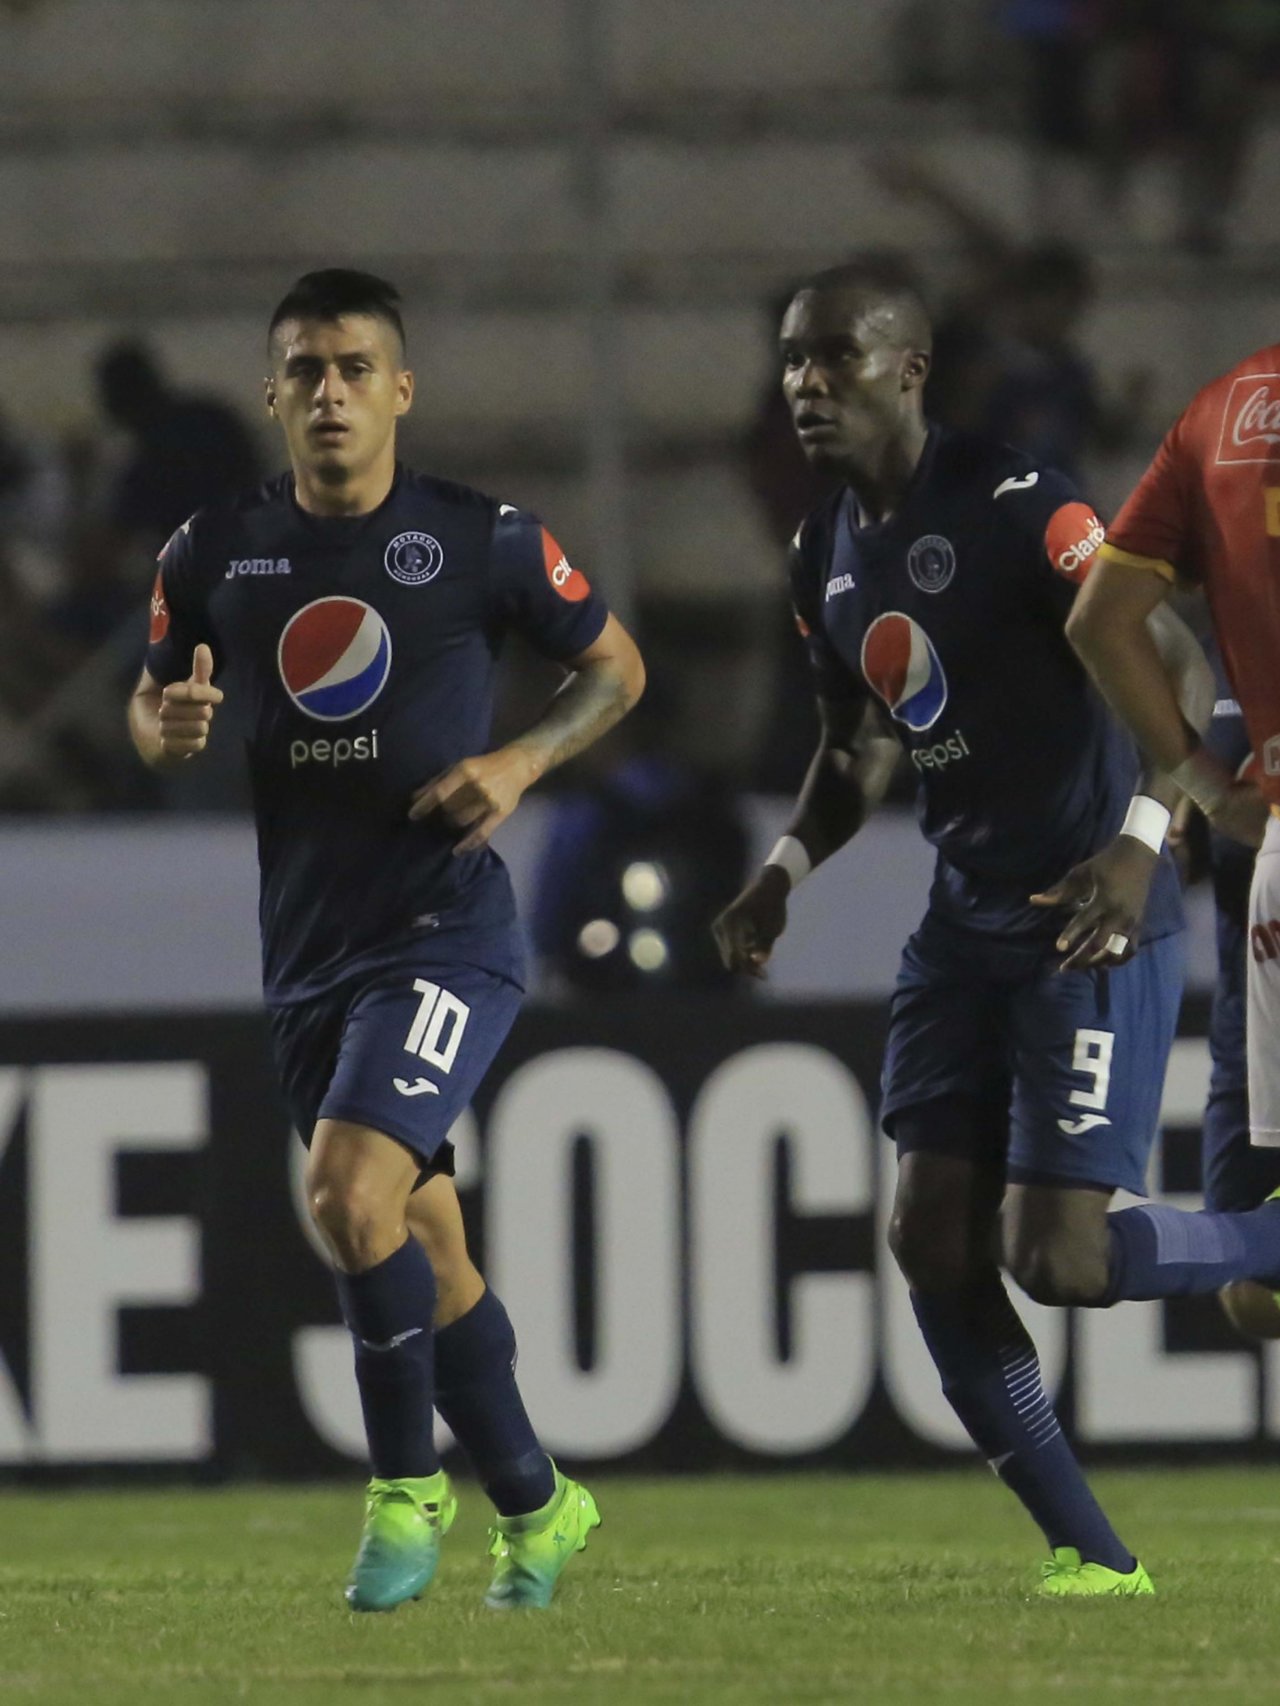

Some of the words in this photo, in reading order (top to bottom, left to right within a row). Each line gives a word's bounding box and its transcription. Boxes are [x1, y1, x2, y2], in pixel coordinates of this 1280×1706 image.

[393, 534, 436, 550] MOTAGUA
[1059, 528, 1105, 571] Claro
[290, 728, 378, 769] pepsi
[403, 978, 470, 1074] 10
[1068, 1030, 1114, 1110] 9
[0, 1061, 213, 1463] E
